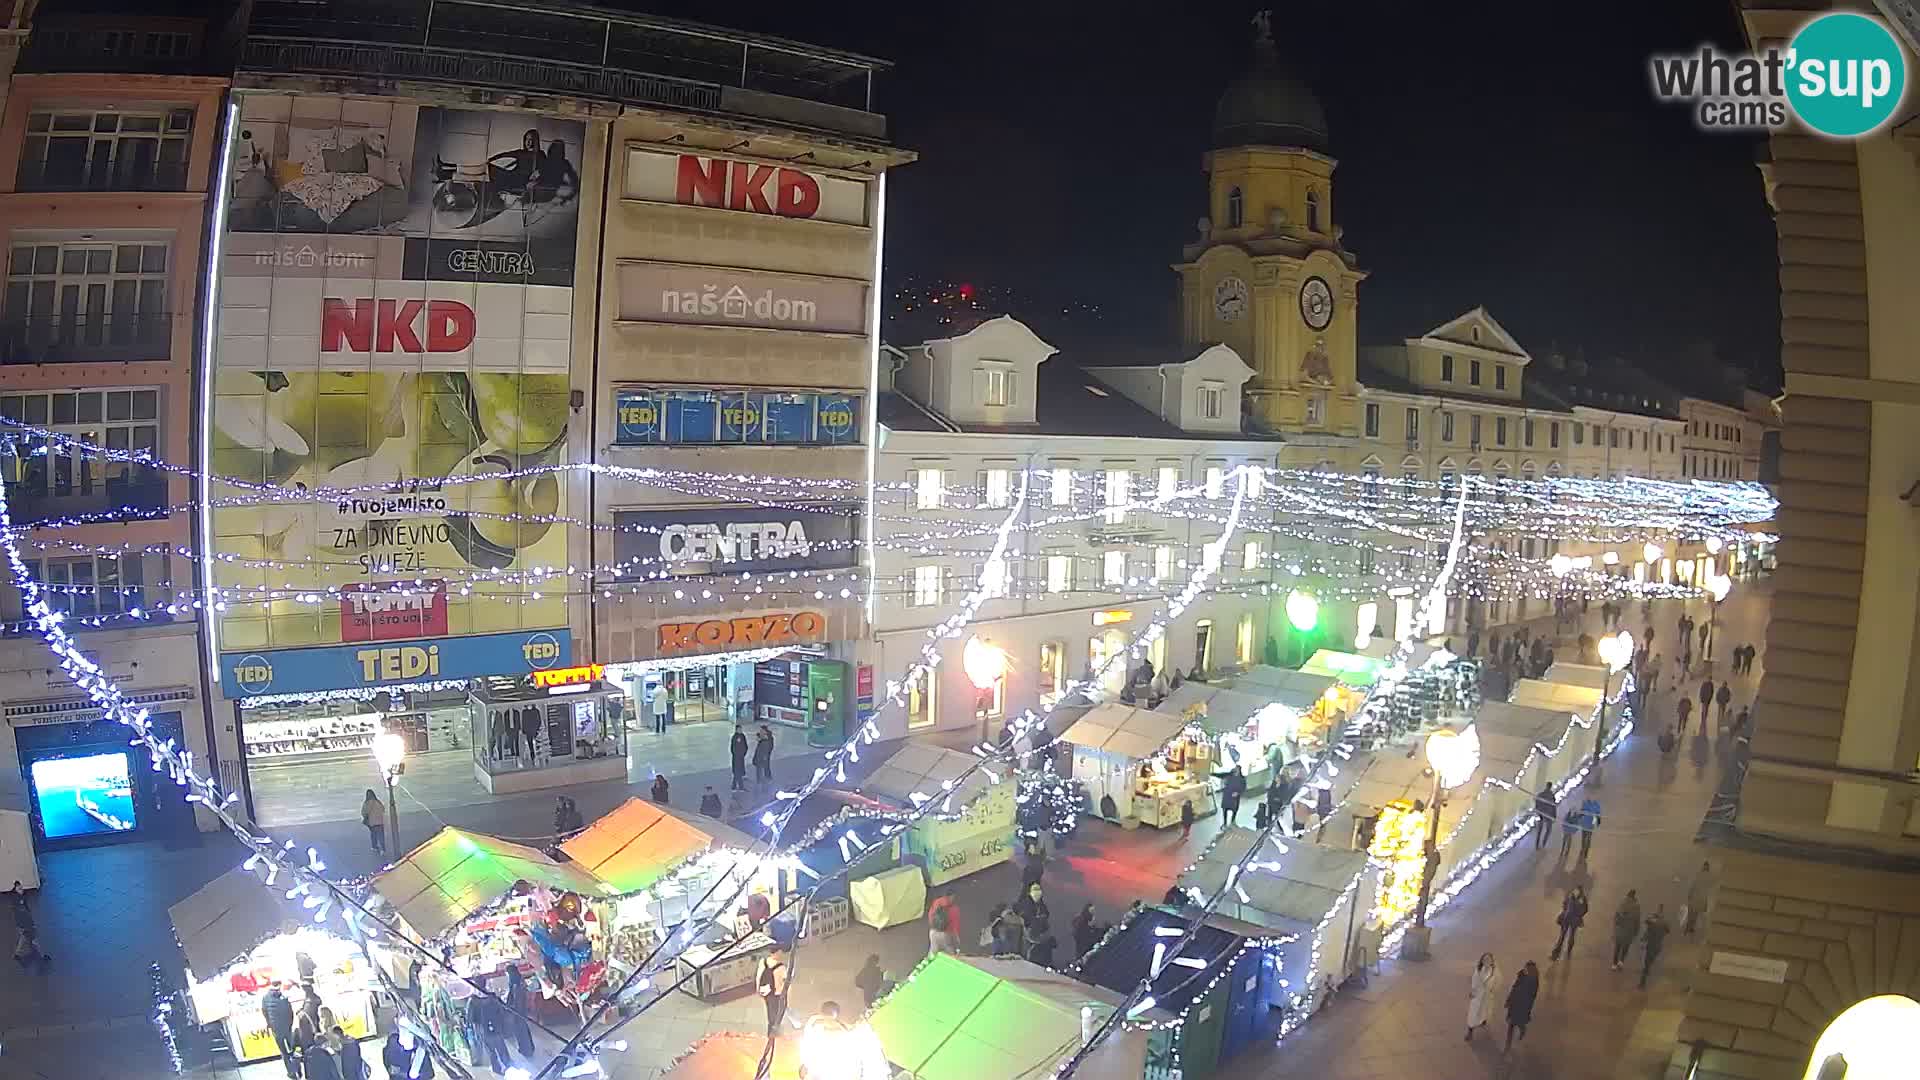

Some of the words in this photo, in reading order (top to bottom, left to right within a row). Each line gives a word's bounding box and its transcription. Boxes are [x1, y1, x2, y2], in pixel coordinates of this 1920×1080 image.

[676, 153, 821, 219] NKD
[448, 249, 536, 276] CENTRA
[662, 284, 718, 316] naš
[754, 289, 816, 322] dom
[321, 296, 477, 353] NKD
[333, 528, 358, 548] ZA
[366, 523, 451, 548] DNEVNO
[659, 520, 810, 563] CENTRA
[658, 612, 825, 650] KORZO
[357, 645, 439, 682] TEDi
[522, 642, 560, 660] TEDi
[233, 664, 272, 684] TEDi
[532, 662, 604, 688] TOMMY
